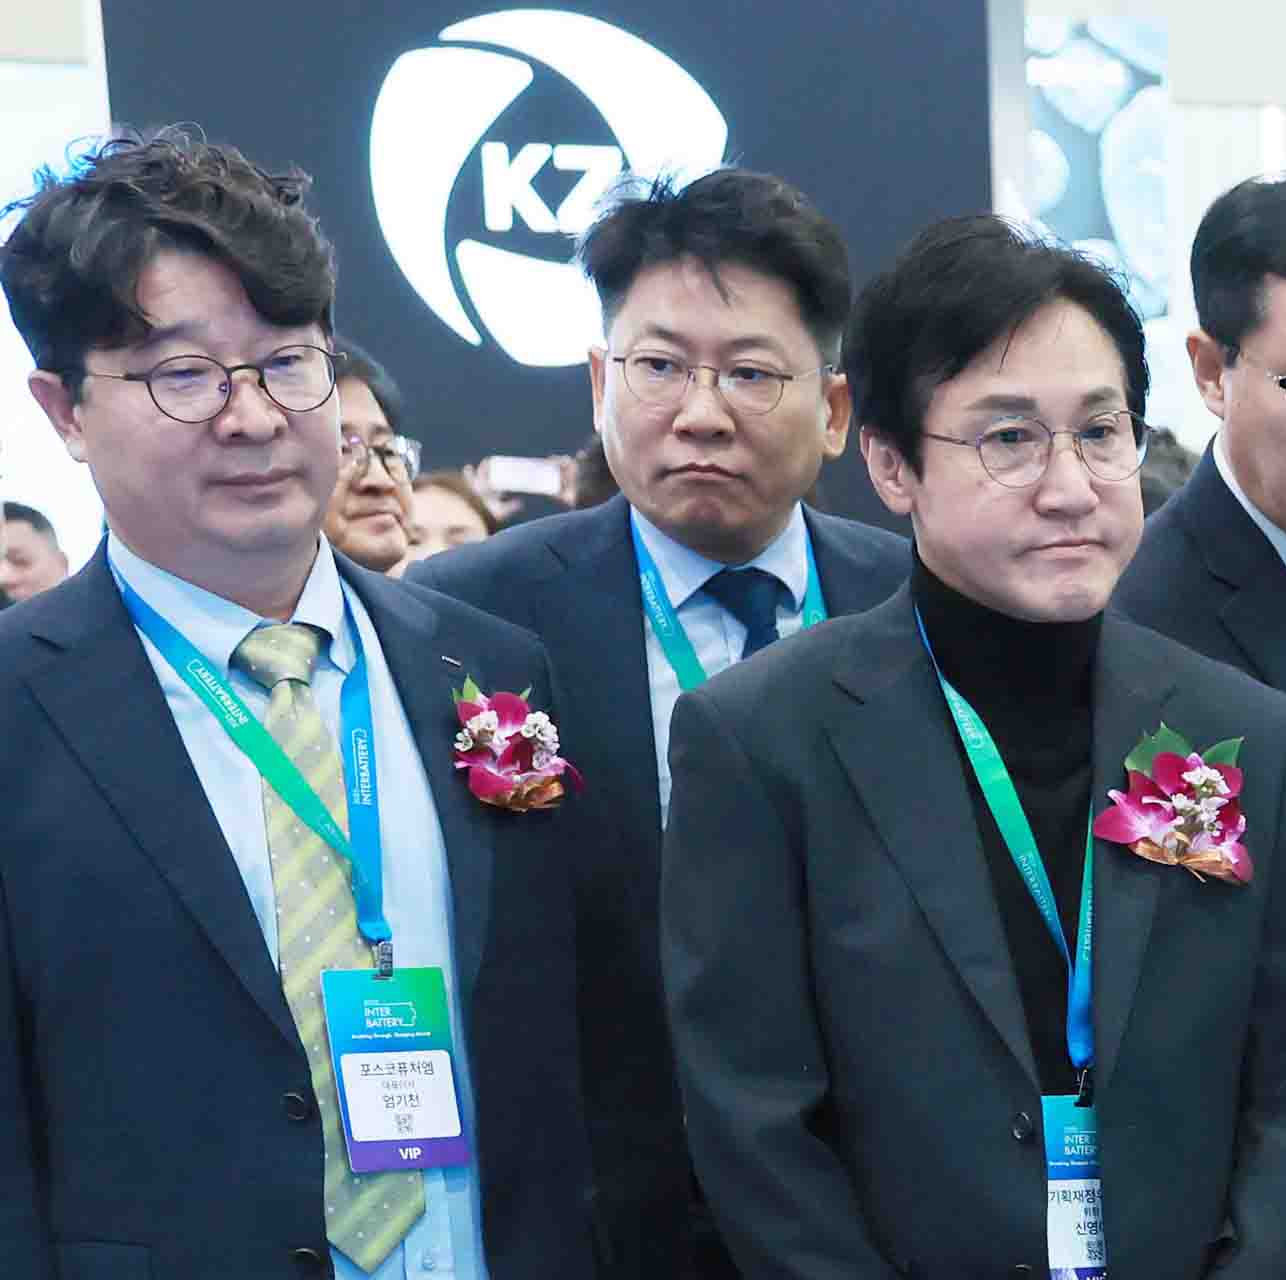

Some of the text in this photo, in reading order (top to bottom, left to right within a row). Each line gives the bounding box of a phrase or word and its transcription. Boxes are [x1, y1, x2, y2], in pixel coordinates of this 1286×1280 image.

[481, 141, 625, 234] KZ
[365, 1007, 393, 1017] INTER
[366, 1017, 404, 1028] BATTERY
[1064, 1134, 1090, 1145] INTER
[398, 1146, 423, 1161] VIP
